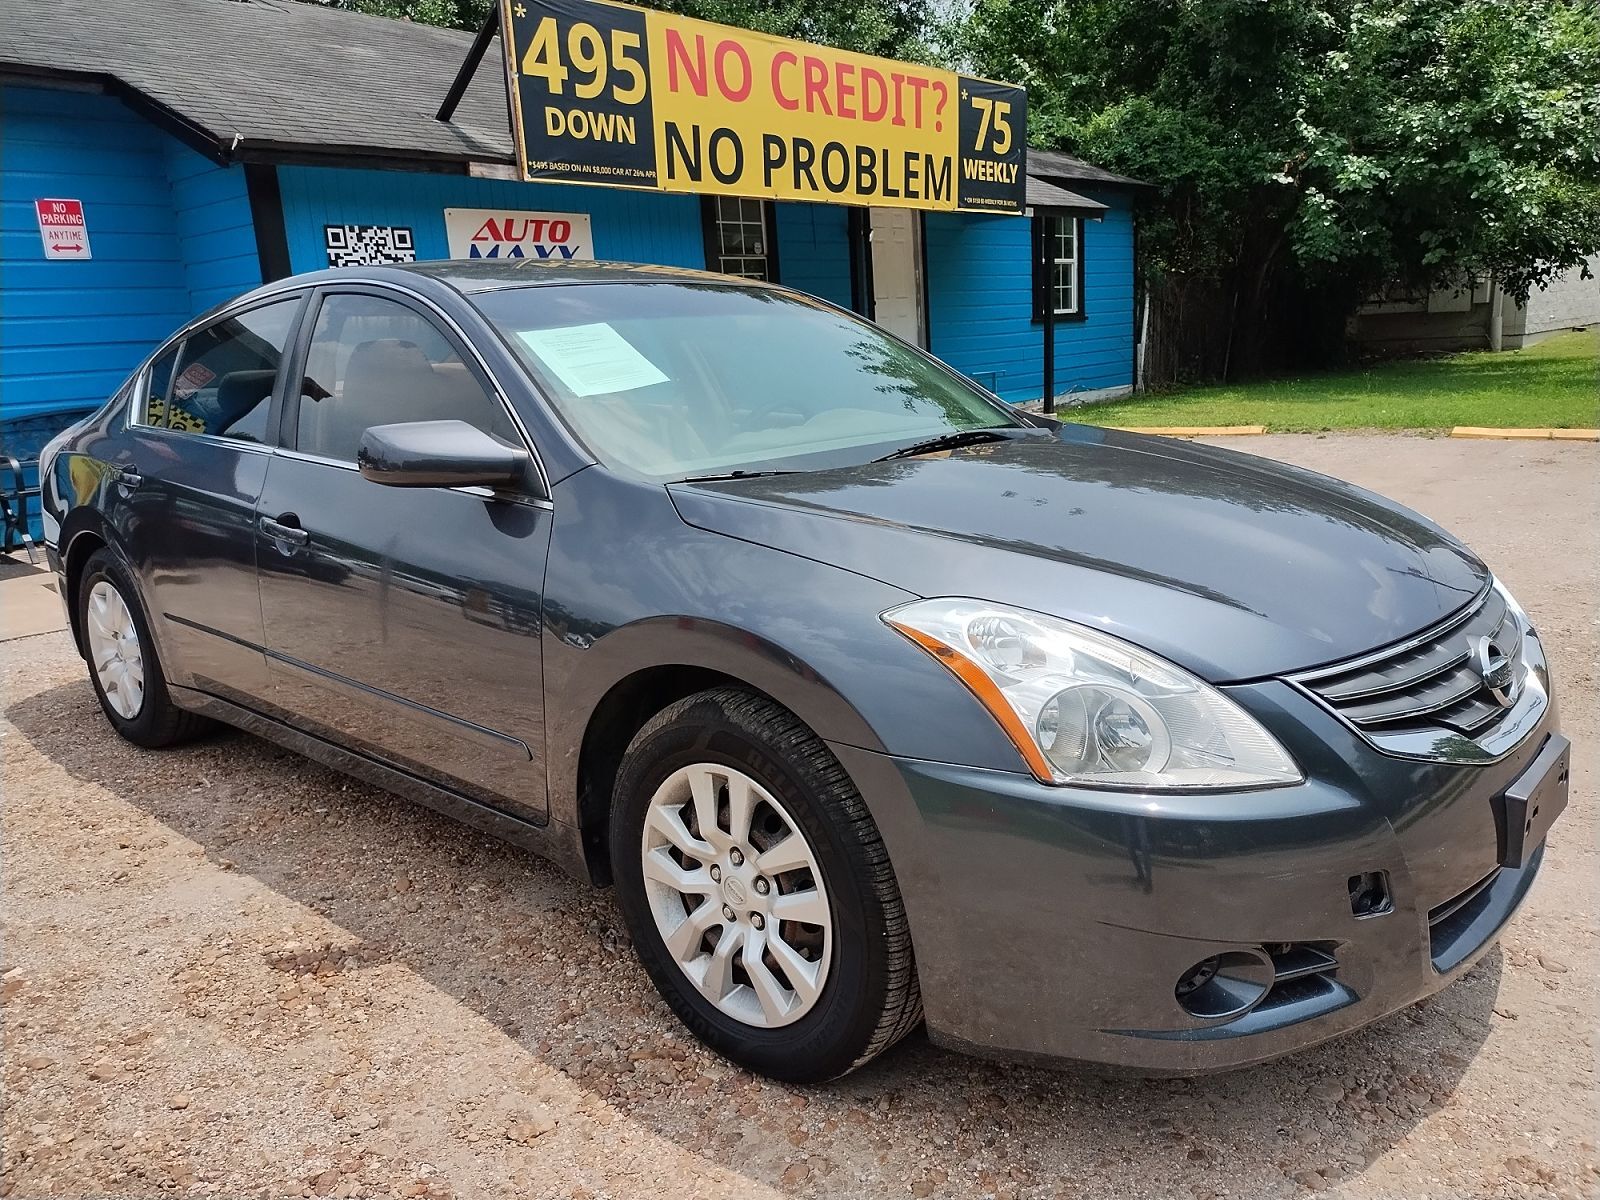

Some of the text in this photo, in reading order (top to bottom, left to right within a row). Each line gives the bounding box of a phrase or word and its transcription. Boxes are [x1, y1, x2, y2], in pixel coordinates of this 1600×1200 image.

[665, 28, 948, 133] NO CREDIT?
[545, 106, 636, 145] DOWN
[549, 162, 570, 171] BASED
[571, 163, 582, 172] ON
[582, 164, 592, 173] AN
[592, 165, 611, 175] $8,000
[612, 167, 624, 176] CAR
[624, 168, 632, 177] AT
[645, 170, 657, 179] APR
[664, 121, 952, 202] NO PROBLEM
[963, 158, 1019, 184] WEEKLY
[41, 213, 83, 225] PARKING
[52, 202, 67, 213] NO
[49, 230, 83, 241] ANYTIME
[471, 218, 571, 243] AUTO
